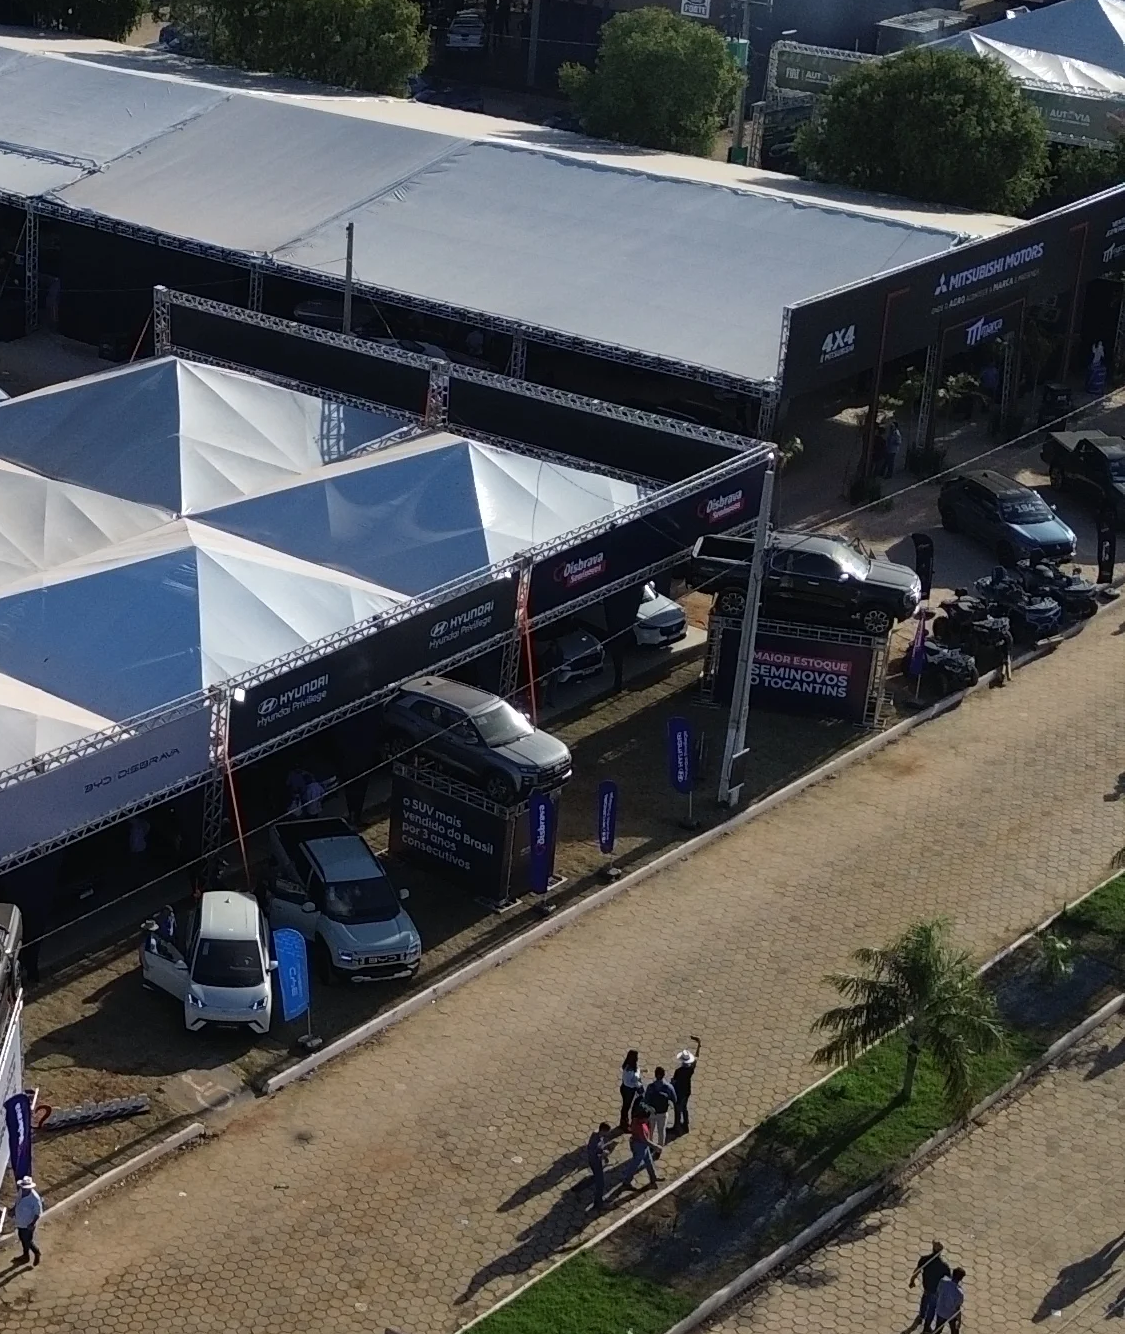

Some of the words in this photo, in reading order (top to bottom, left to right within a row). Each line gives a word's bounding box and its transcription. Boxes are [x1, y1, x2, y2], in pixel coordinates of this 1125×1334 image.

[948, 257, 1005, 291] MITSUBISHI
[1004, 242, 1045, 271] MOTORS
[706, 489, 743, 514] Disbrava
[563, 551, 604, 578] Disbrava
[450, 599, 495, 629] HYUNDAI
[428, 629, 460, 650] Hyundai
[751, 663, 849, 687] SEMINOVOS
[754, 651, 791, 665] MAIOR
[793, 656, 850, 672] ESTOQUE
[279, 673, 329, 706] HYUNDAI
[763, 676, 848, 698] TOCANTINS
[256, 706, 291, 728] Hyundai
[84, 776, 113, 794] BYD
[117, 748, 180, 779] DISBRAVA
[412, 798, 435, 816] SUV
[435, 810, 462, 828] mais
[402, 809, 446, 834] vendido
[446, 827, 462, 841] do
[463, 833, 495, 856] Brasil
[402, 821, 422, 836] por
[422, 828, 430, 839] 3
[430, 833, 457, 851] anos
[401, 834, 471, 870] consecutivos
